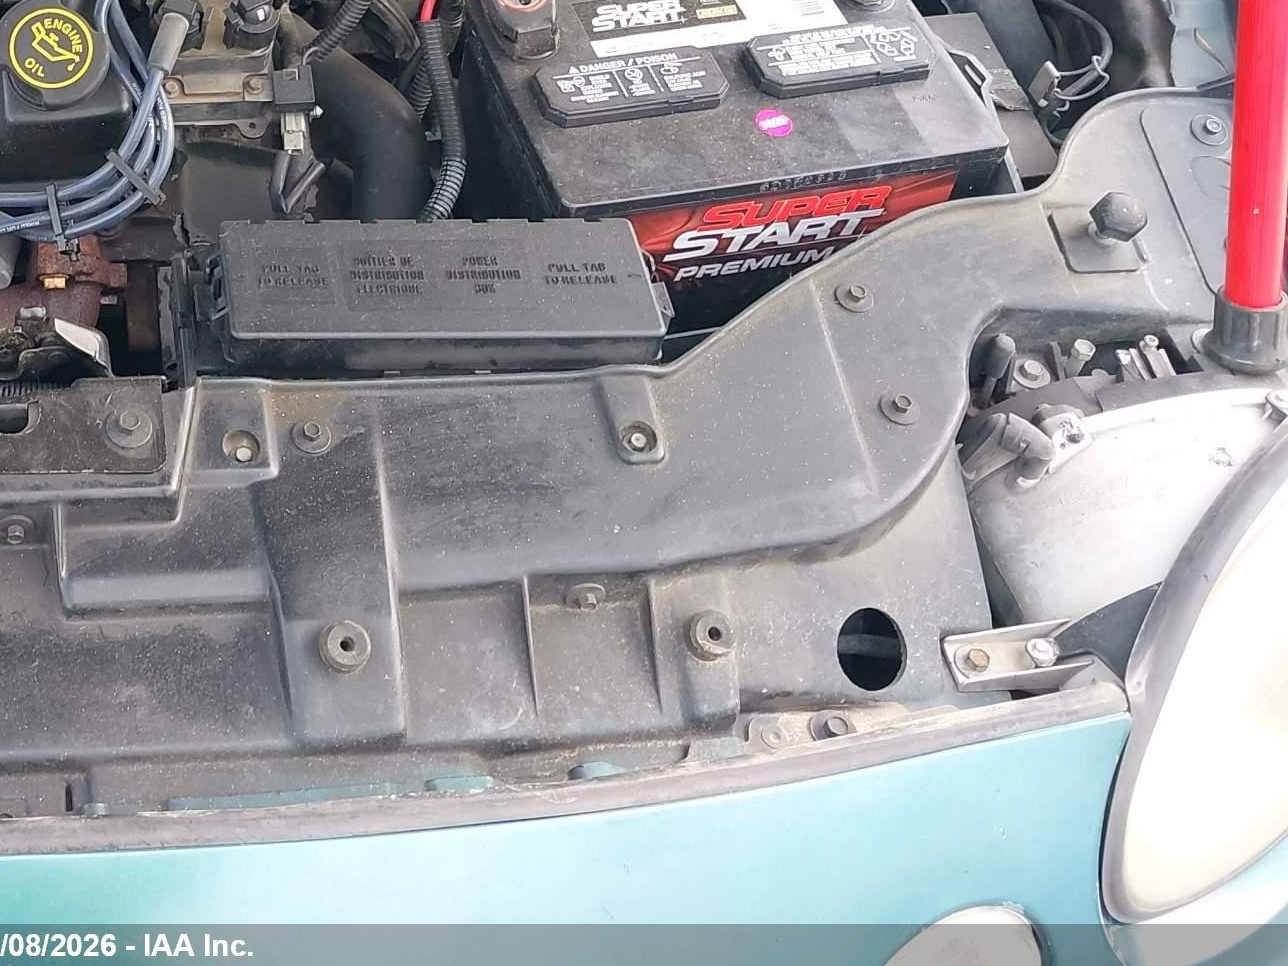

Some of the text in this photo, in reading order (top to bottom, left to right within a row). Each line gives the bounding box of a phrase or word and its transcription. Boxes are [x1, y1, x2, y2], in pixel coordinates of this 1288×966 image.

[592, 11, 685, 32] START
[43, 18, 83, 53] ENGINE
[24, 57, 45, 77] OIL
[579, 59, 627, 73] DANGER
[636, 52, 678, 65] POISON
[697, 185, 893, 231] SUPER
[662, 208, 886, 263] START
[262, 265, 290, 274] PULL
[462, 256, 499, 266] POWER
[548, 263, 607, 272] PULL TAB
[673, 246, 835, 282] PREMIUM
[350, 270, 424, 280] DISTRIBUTION
[446, 269, 521, 280] DISTRIBUTION
[544, 275, 561, 285] TO
[561, 275, 617, 285] RELEASE
